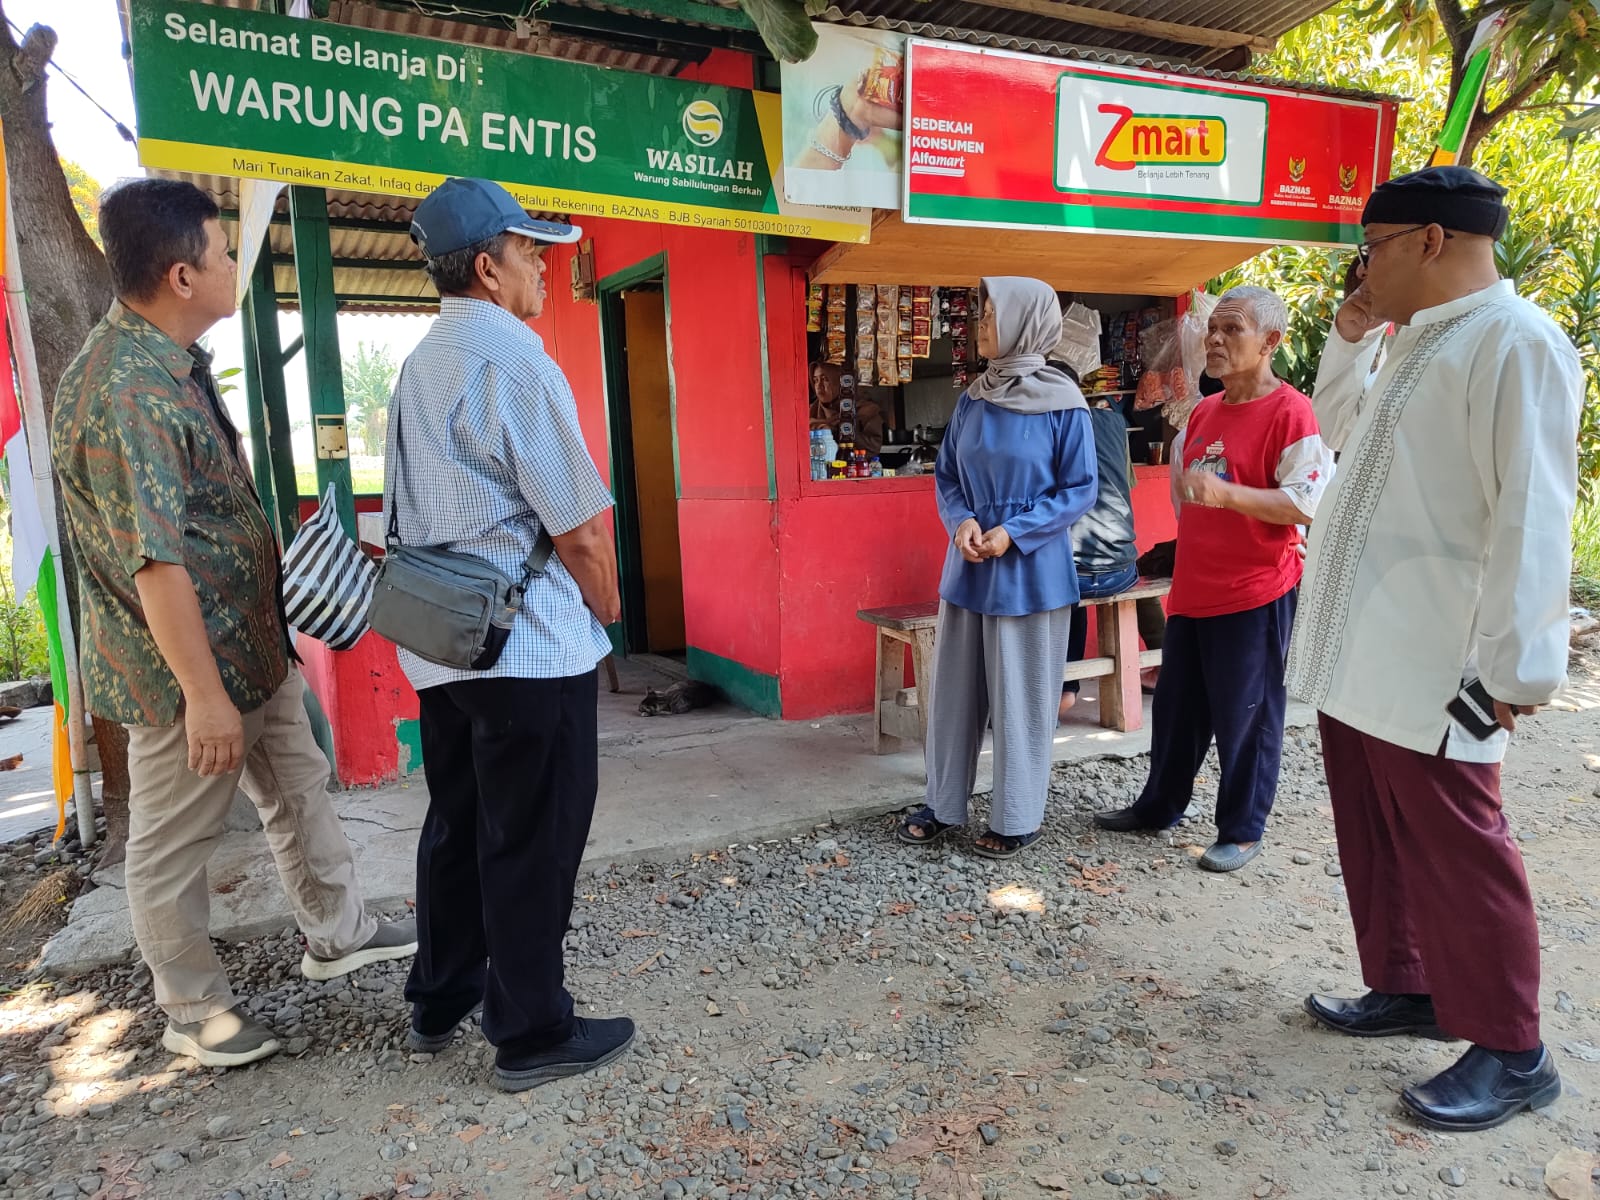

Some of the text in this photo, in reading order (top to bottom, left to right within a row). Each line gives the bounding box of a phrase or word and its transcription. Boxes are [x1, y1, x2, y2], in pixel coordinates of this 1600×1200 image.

[164, 12, 485, 86] Selamat Belanja Di :
[189, 69, 598, 163] WARUNG PA ENTIS
[912, 117, 973, 135] SEDEKAH
[912, 136, 985, 154] KONSUMEN
[646, 147, 754, 182] WASILAH
[911, 150, 966, 168] Alfamart
[232, 158, 264, 174] Mari
[268, 162, 331, 181] Tunaikan
[379, 176, 412, 194] Infaq
[633, 171, 763, 197] Warung Sabilulungan Berkah
[1137, 170, 1210, 181] Belanja Lebih Tenang
[1279, 184, 1311, 195] BAZNAS
[1328, 194, 1363, 206] BAZNAS
[552, 197, 605, 215] Rekening
[612, 204, 660, 220] BAZNAS
[669, 209, 691, 224] BJB
[693, 212, 732, 228] Syariah
[734, 217, 812, 236] 5010301010732
